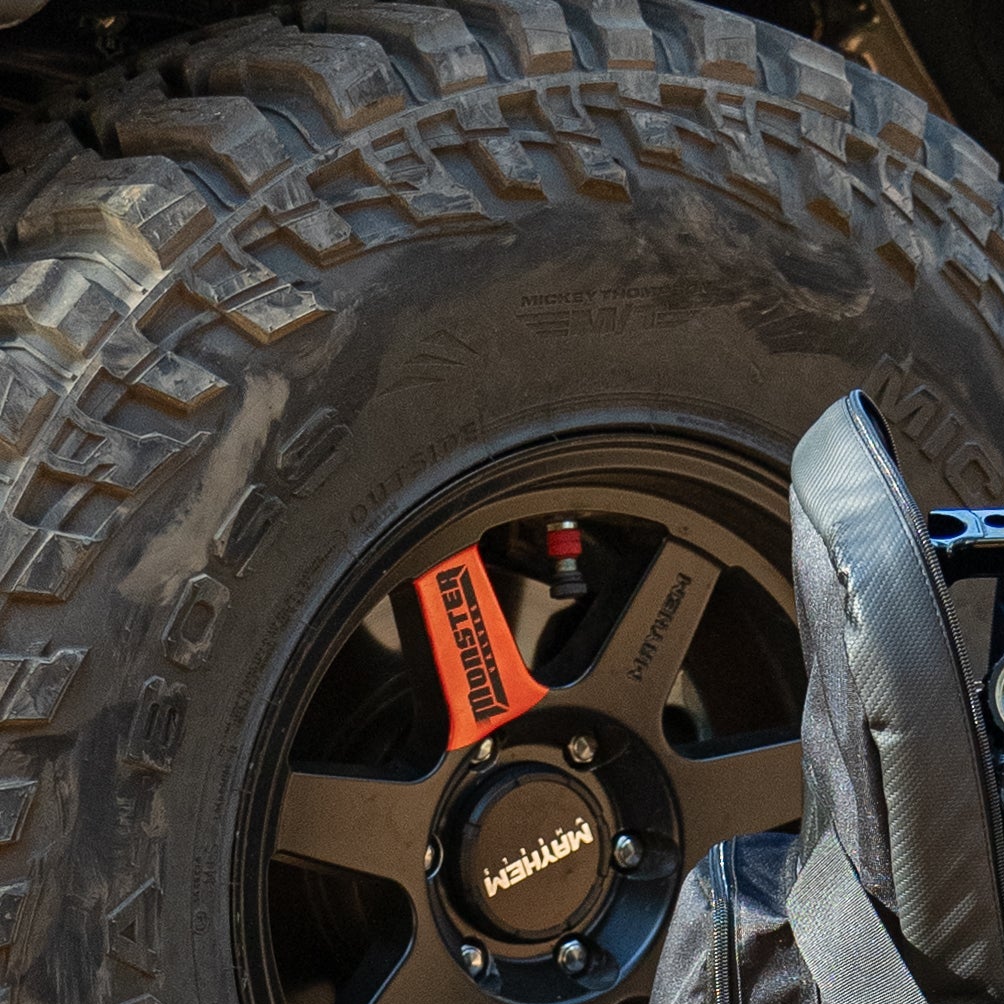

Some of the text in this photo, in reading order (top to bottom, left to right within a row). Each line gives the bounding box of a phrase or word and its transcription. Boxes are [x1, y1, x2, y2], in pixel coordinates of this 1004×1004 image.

[520, 290, 598, 307] MICKEY
[121, 403, 355, 771] BOSS
[628, 572, 692, 683] MAYHEM
[435, 564, 510, 723] MONSTER
[484, 821, 594, 897] MAYHEM
